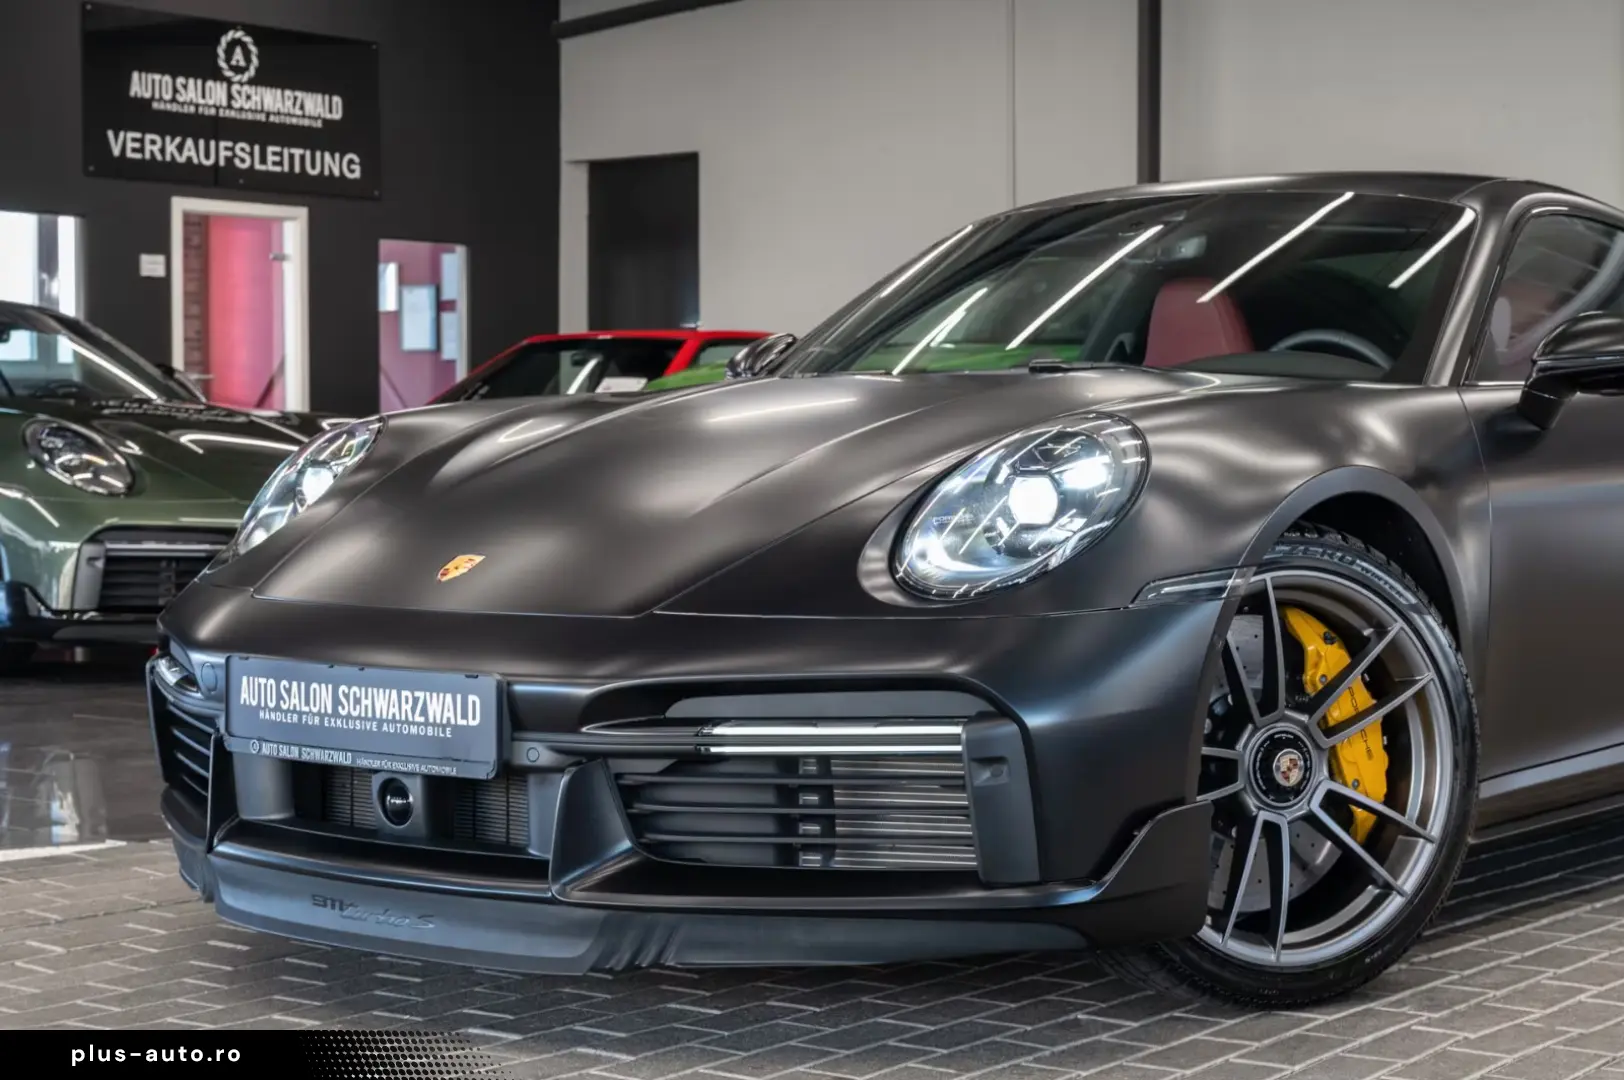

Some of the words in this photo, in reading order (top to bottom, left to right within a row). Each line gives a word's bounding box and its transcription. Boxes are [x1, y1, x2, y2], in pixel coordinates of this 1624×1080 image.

[230, 45, 246, 67] A
[129, 71, 173, 101] AUTO
[175, 77, 228, 108] SALON
[231, 83, 343, 121] SCHWARZWALD
[107, 129, 362, 179] VERKAUFSLEITUNG
[240, 675, 276, 708] AUTO
[279, 680, 332, 714] SALON
[338, 685, 480, 727] SCHWARZWALD
[259, 709, 298, 724] HÄNDLER
[302, 713, 320, 726] FÜR
[324, 717, 378, 732] EXKLUSIVE
[382, 723, 452, 738] AUTOMOBILE
[262, 743, 278, 756] AUTO
[278, 744, 299, 758] SALON
[301, 747, 352, 764] SCHWARZWALD
